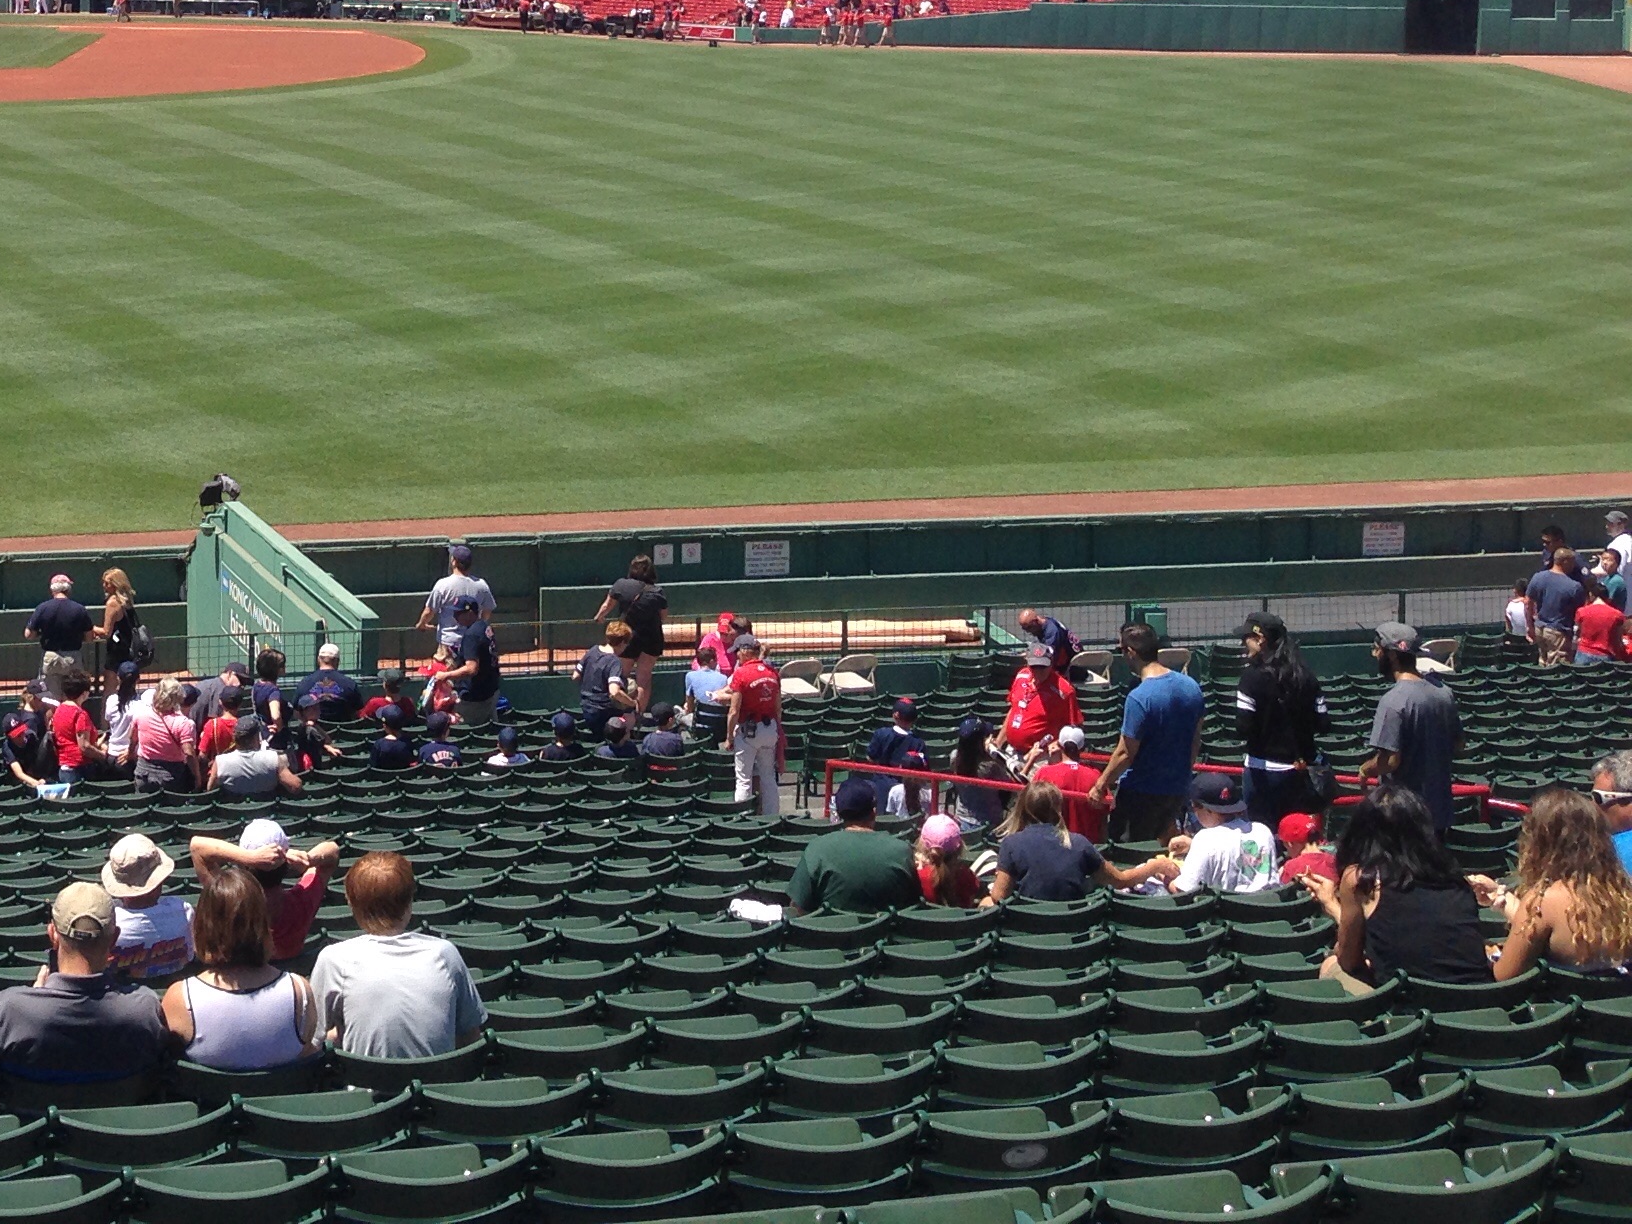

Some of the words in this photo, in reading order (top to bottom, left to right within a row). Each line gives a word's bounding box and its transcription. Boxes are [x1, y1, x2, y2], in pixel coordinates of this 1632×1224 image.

[229, 579, 252, 617] KONICA
[252, 603, 283, 644] MINOLTA
[230, 608, 261, 659] bizhb
